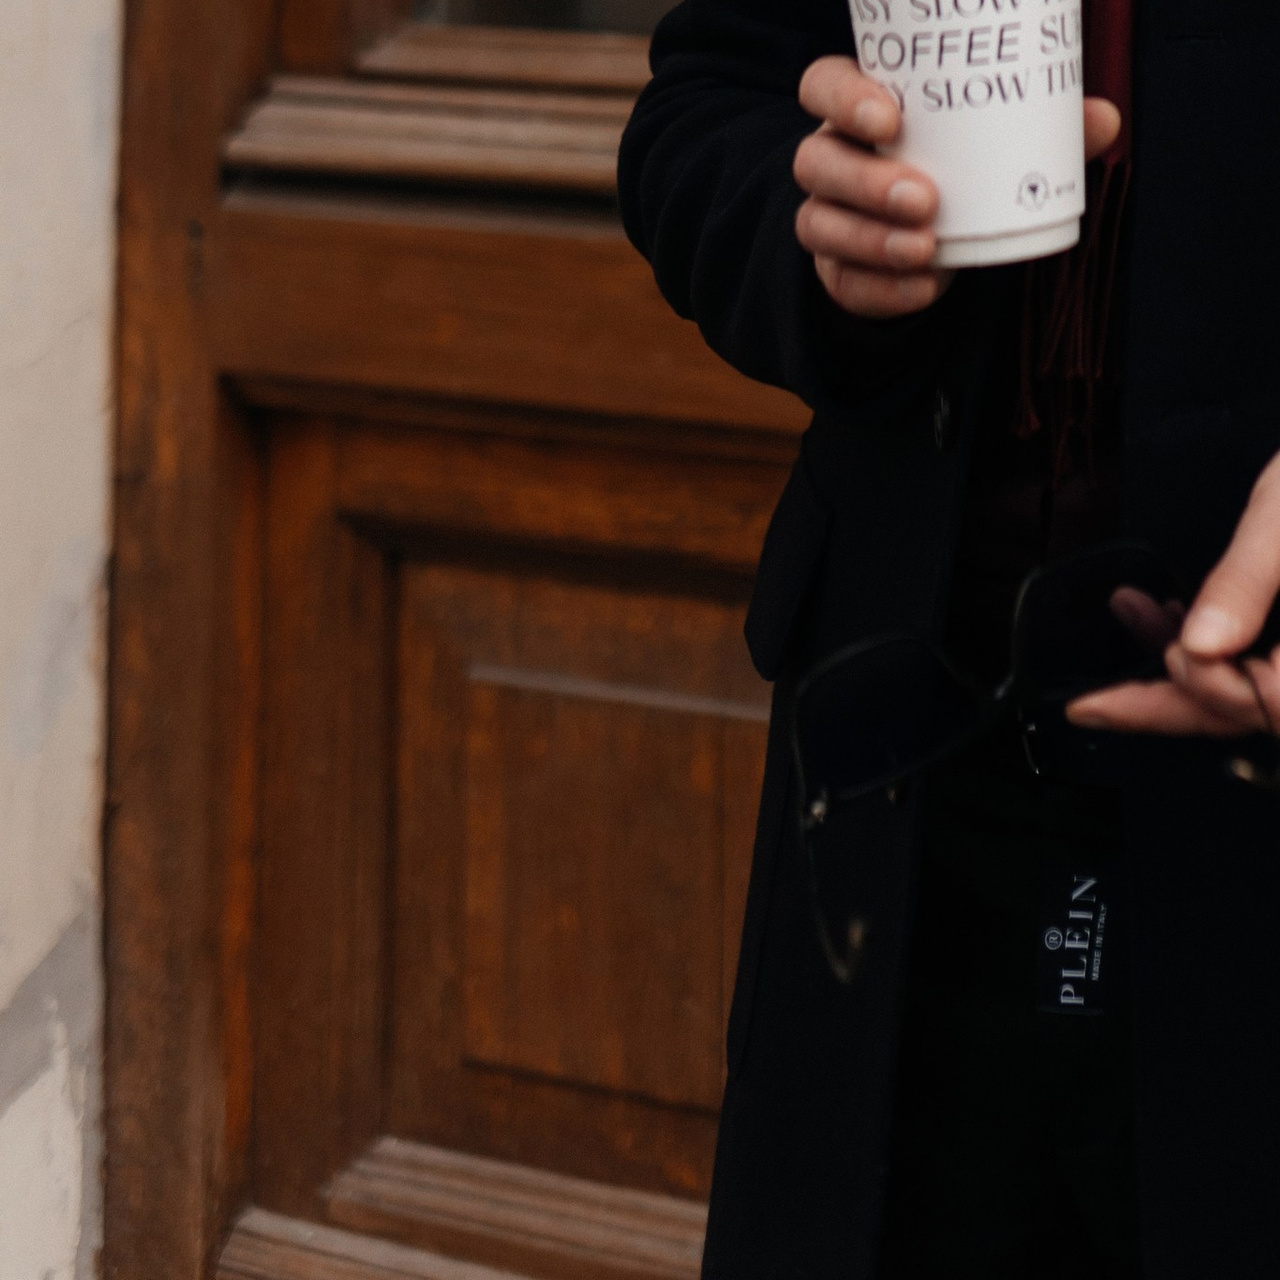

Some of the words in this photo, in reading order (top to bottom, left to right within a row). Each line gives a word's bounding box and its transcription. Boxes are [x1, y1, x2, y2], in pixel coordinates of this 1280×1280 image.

[860, 21, 1022, 72] COFFEE
[922, 66, 1030, 113] SLOW
[1097, 903, 1108, 933] ITALY
[1060, 874, 1098, 1006] PLEIN
[1095, 936, 1104, 948] IN
[1092, 951, 1102, 981] MADE
